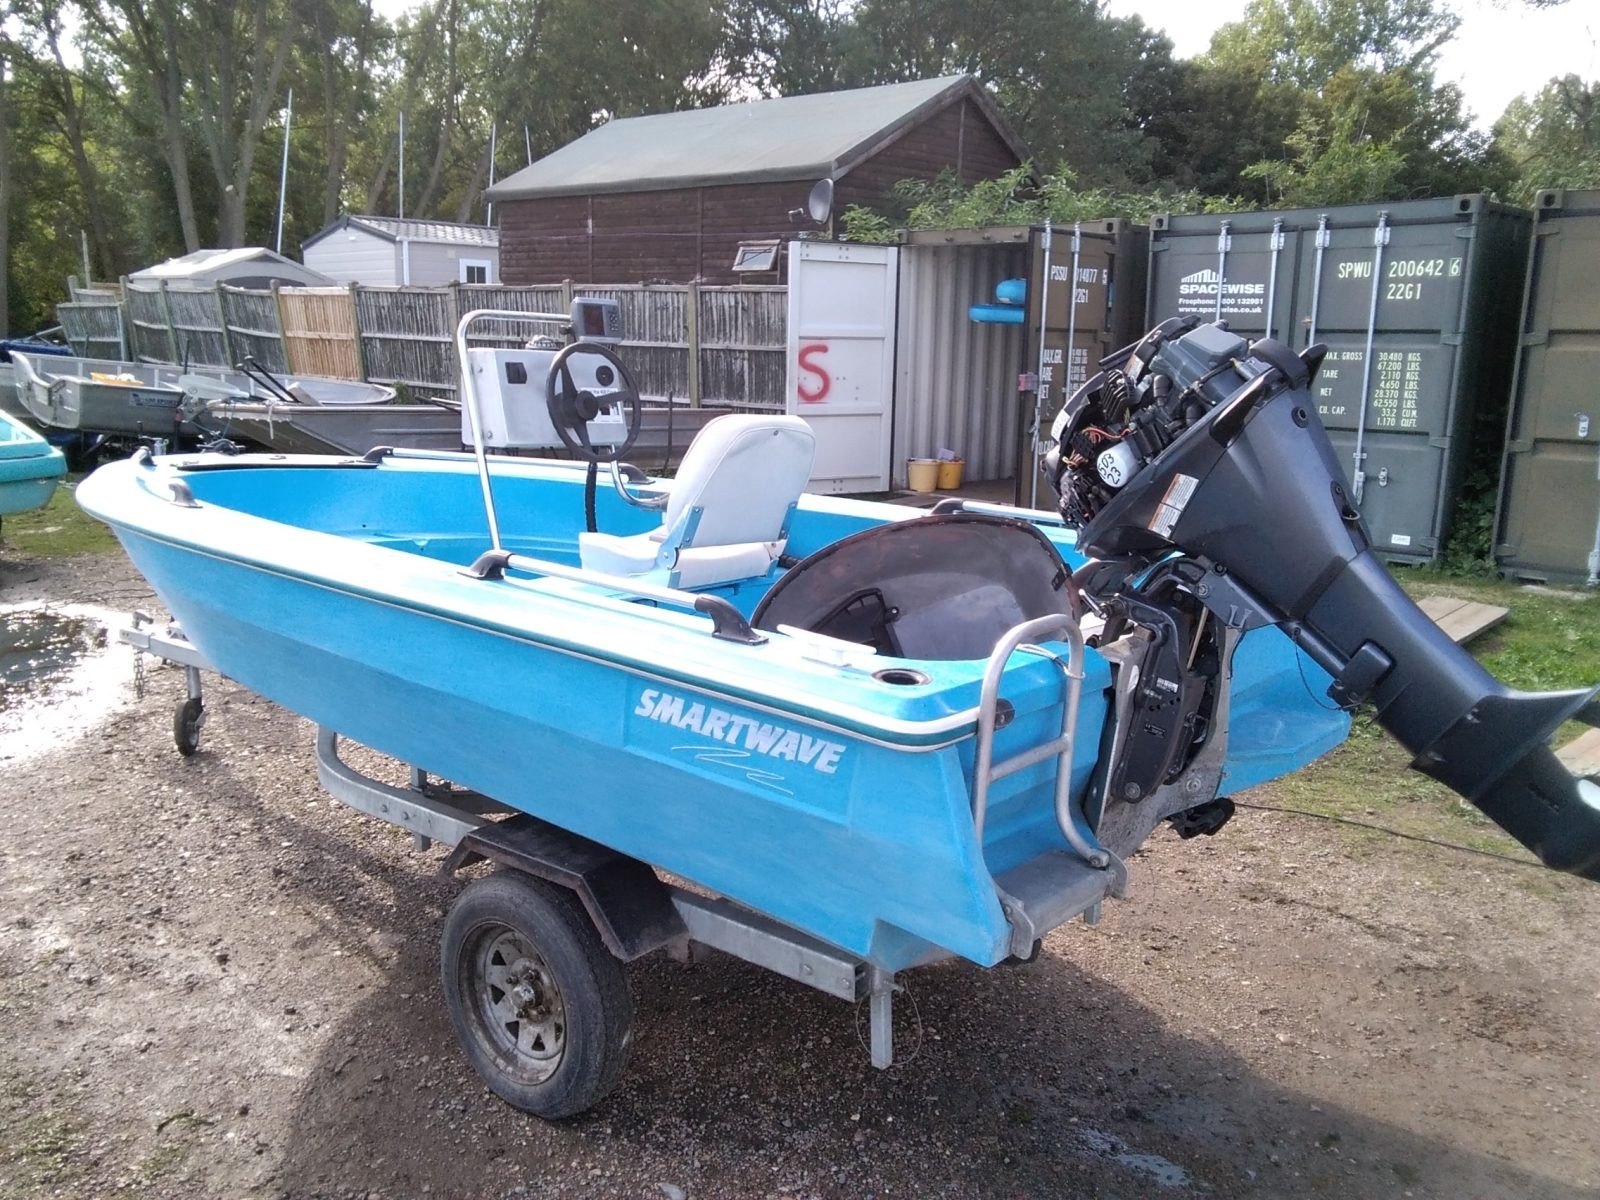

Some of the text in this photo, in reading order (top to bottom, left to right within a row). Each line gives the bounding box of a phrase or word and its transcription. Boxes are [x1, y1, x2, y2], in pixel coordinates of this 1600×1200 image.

[1338, 258, 1461, 279] SPWU 200642 6
[1179, 283, 1264, 294] SPACEWISE
[1387, 283, 1421, 300] 22G1
[1178, 297, 1216, 306] Freephone:
[1342, 352, 1363, 361] GROSS
[1378, 352, 1403, 361] 30.480
[1407, 353, 1422, 362] KGS.
[1377, 362, 1421, 371] 67.200 LBS.
[798, 344, 831, 403] S
[1042, 366, 1053, 382] ARE
[1322, 369, 1420, 381] TARE 2.110 KGS.
[1379, 380, 1419, 390] 4.650 LBS.
[1320, 387, 1418, 399] NET 28.370 KGS.
[1373, 399, 1417, 409] 62.550 LBS.
[1331, 406, 1347, 415] CAP.
[1381, 408, 1397, 417] 33.2
[1377, 417, 1396, 426] 1.170
[1107, 466, 1122, 485] 23
[634, 689, 846, 774] SMARTWAVE
